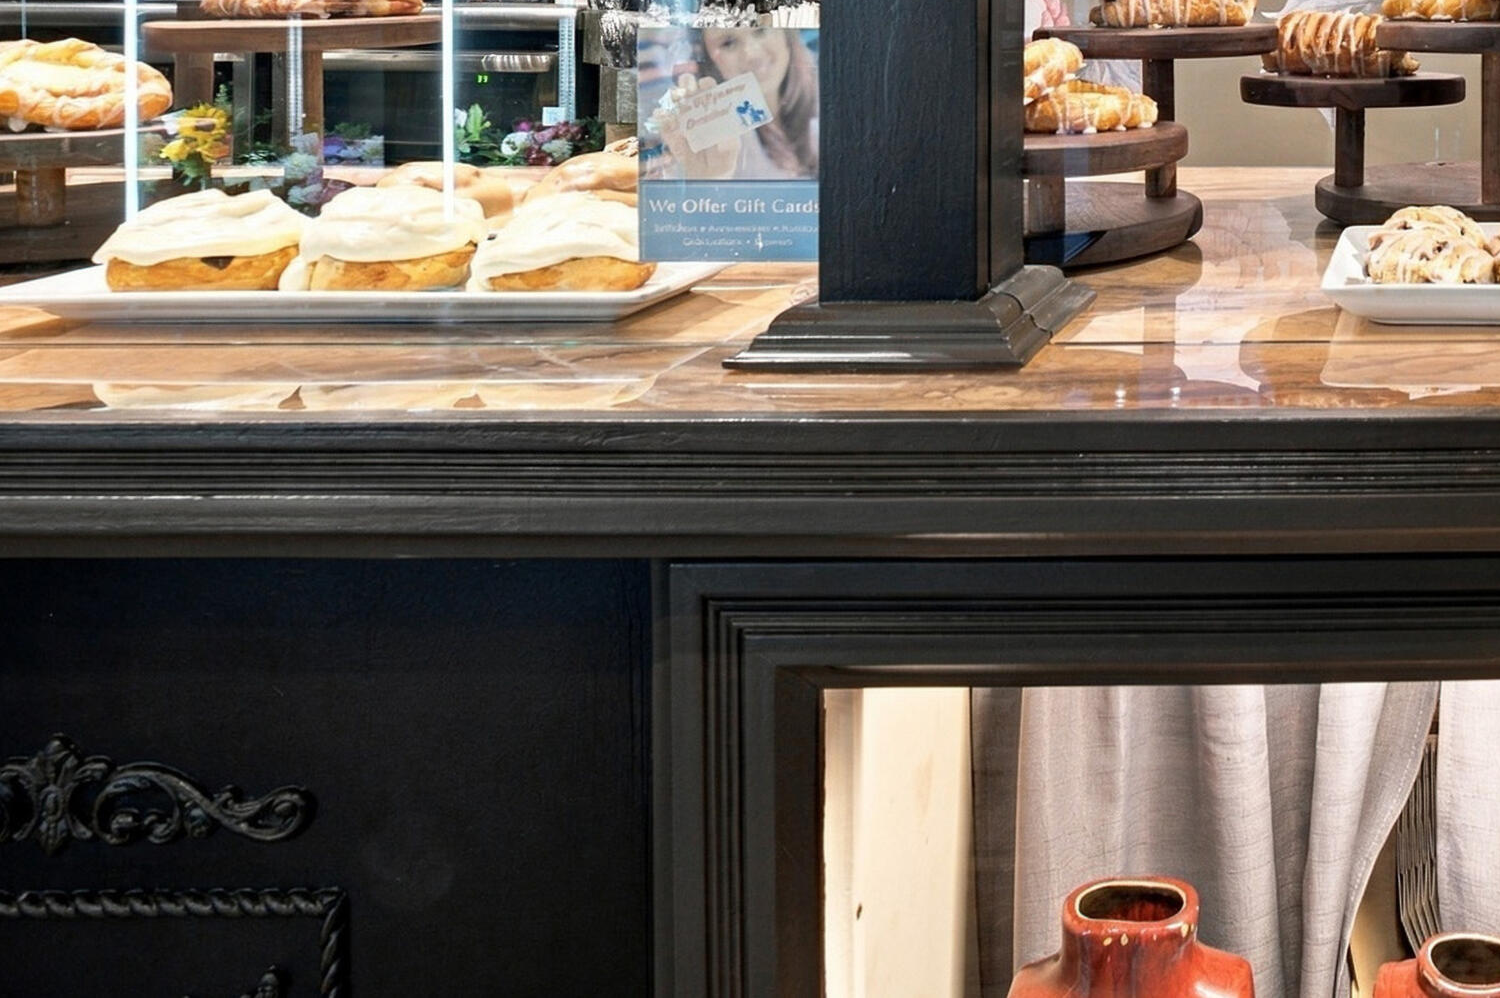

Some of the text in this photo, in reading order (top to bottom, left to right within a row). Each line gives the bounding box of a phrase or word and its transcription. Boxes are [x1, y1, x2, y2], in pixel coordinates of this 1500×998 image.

[649, 199, 676, 213] We
[681, 198, 727, 214] Offer
[734, 198, 766, 214] Gift
